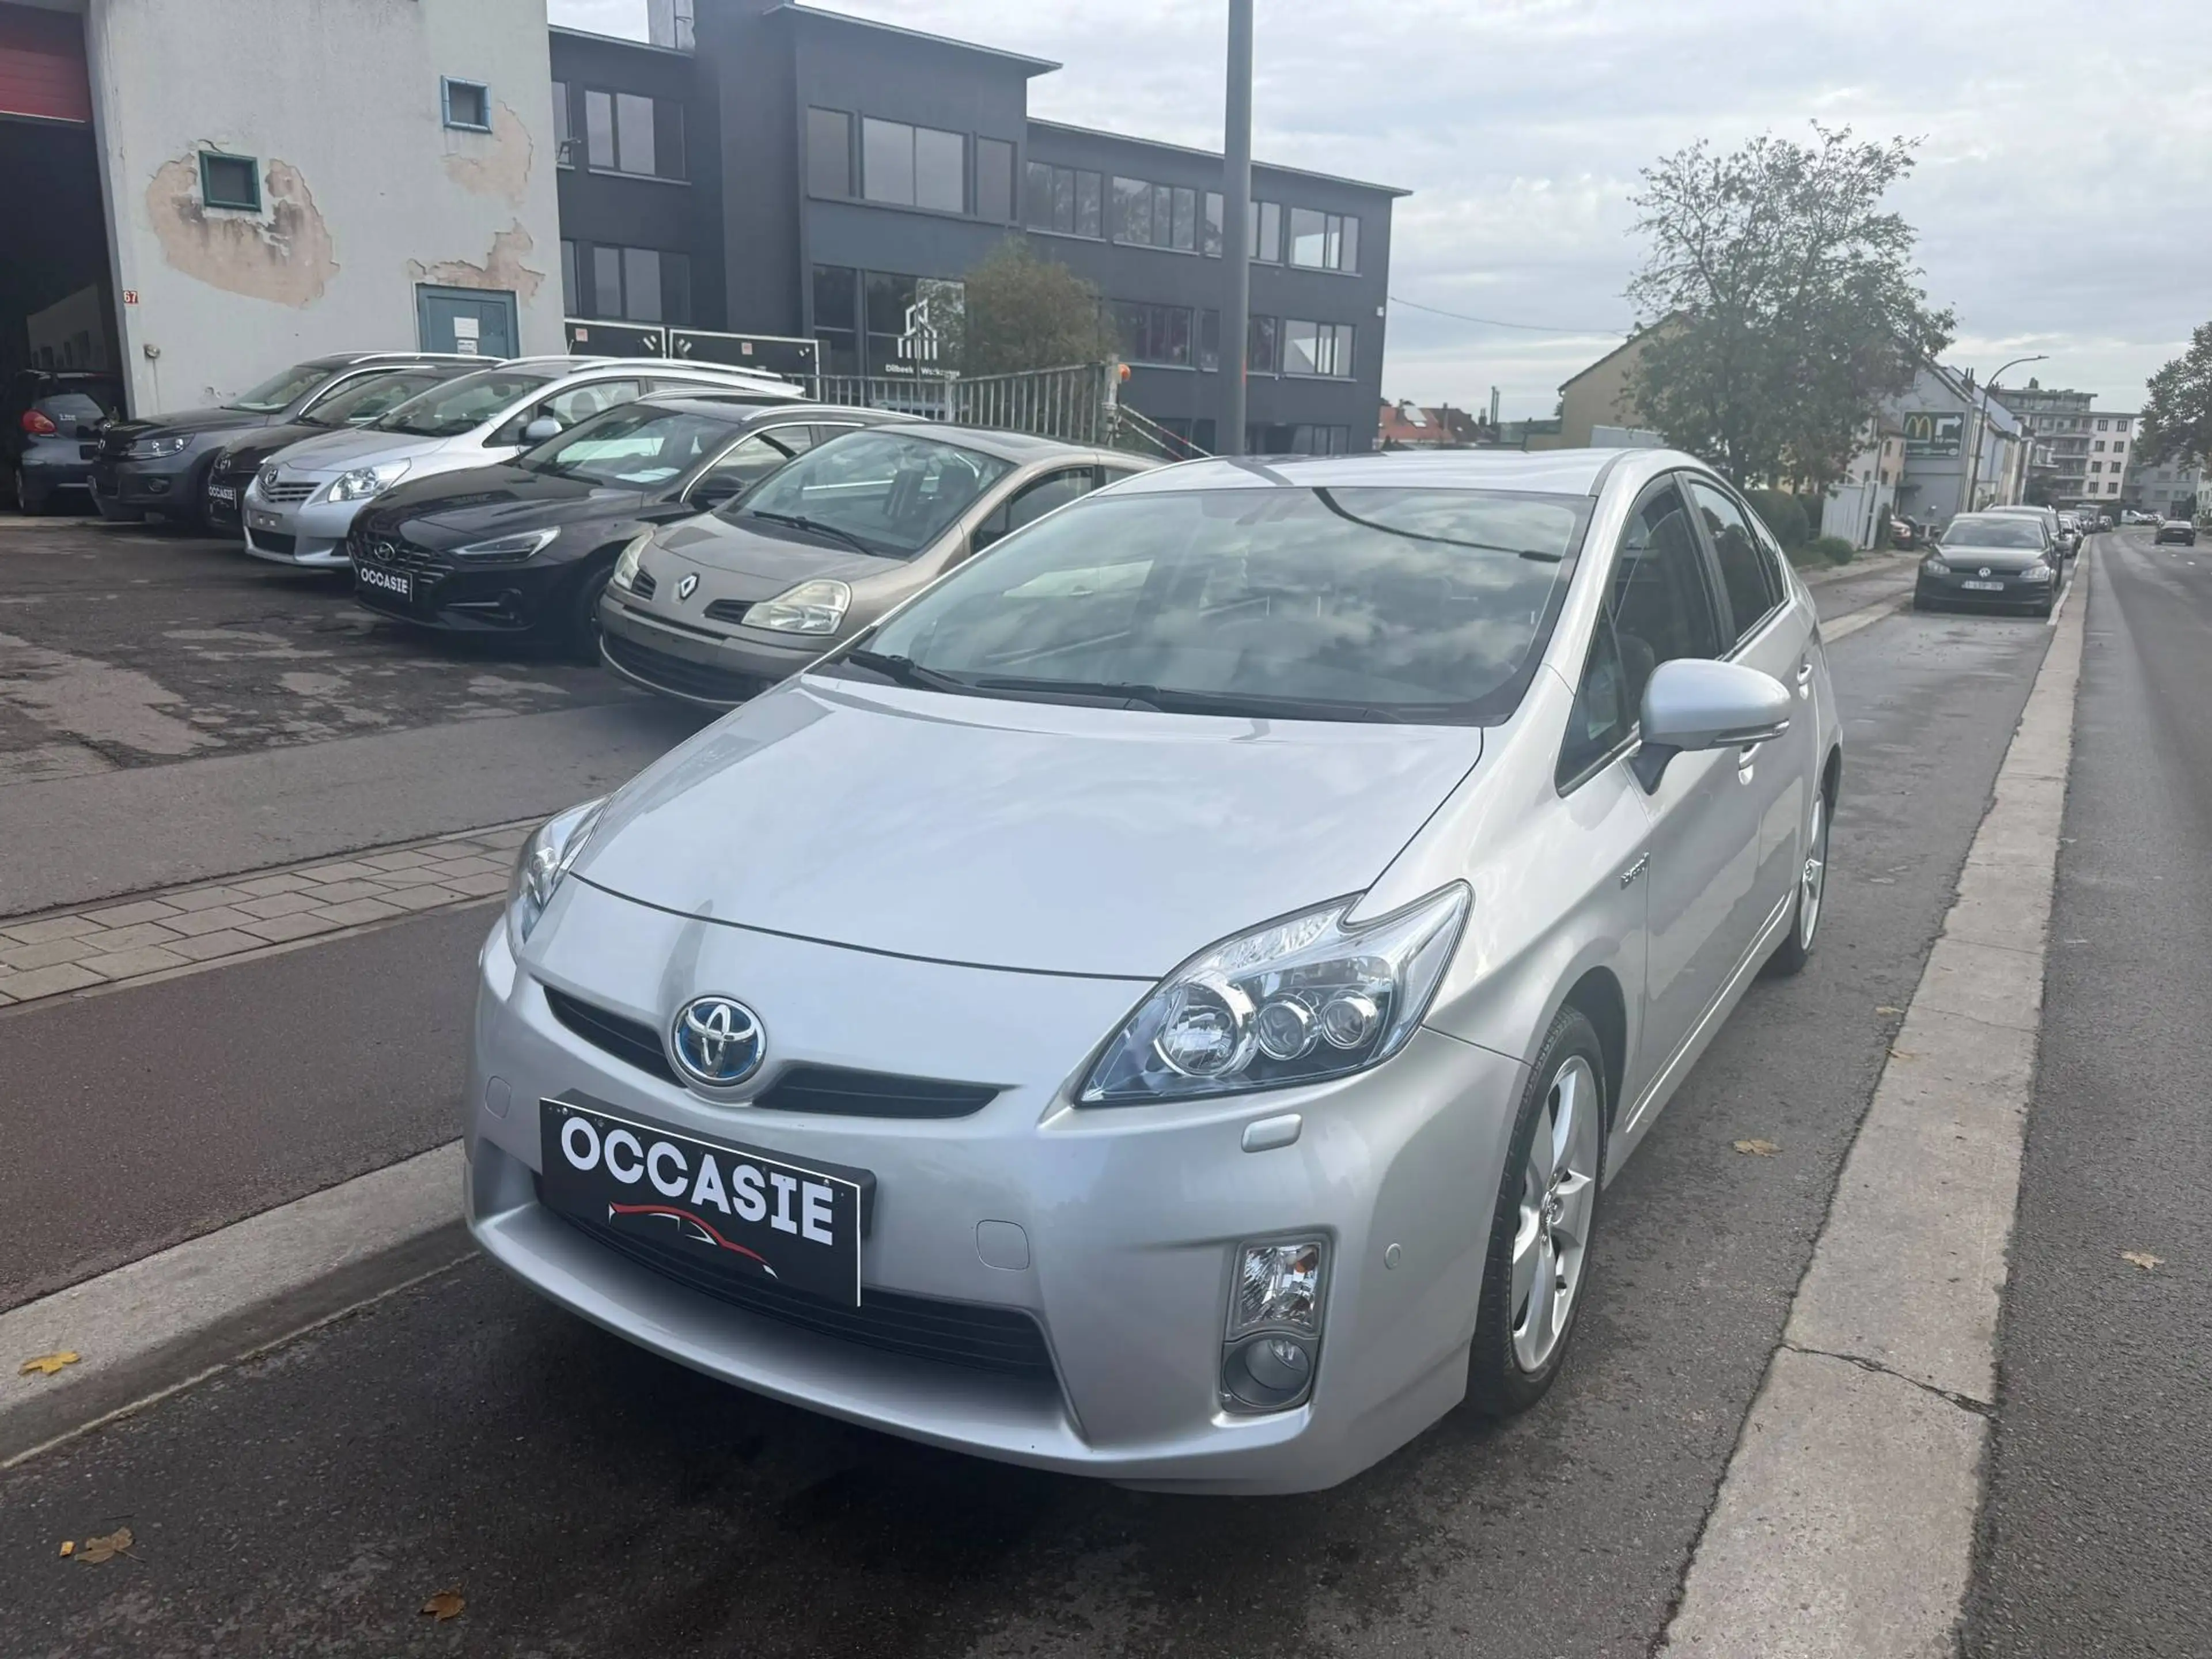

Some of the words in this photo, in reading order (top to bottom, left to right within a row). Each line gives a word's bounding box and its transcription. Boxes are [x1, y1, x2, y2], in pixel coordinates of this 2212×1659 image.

[124, 291, 137, 302] 67
[361, 567, 408, 594] OCCASIE
[561, 1116, 833, 1246] OCCASIE
